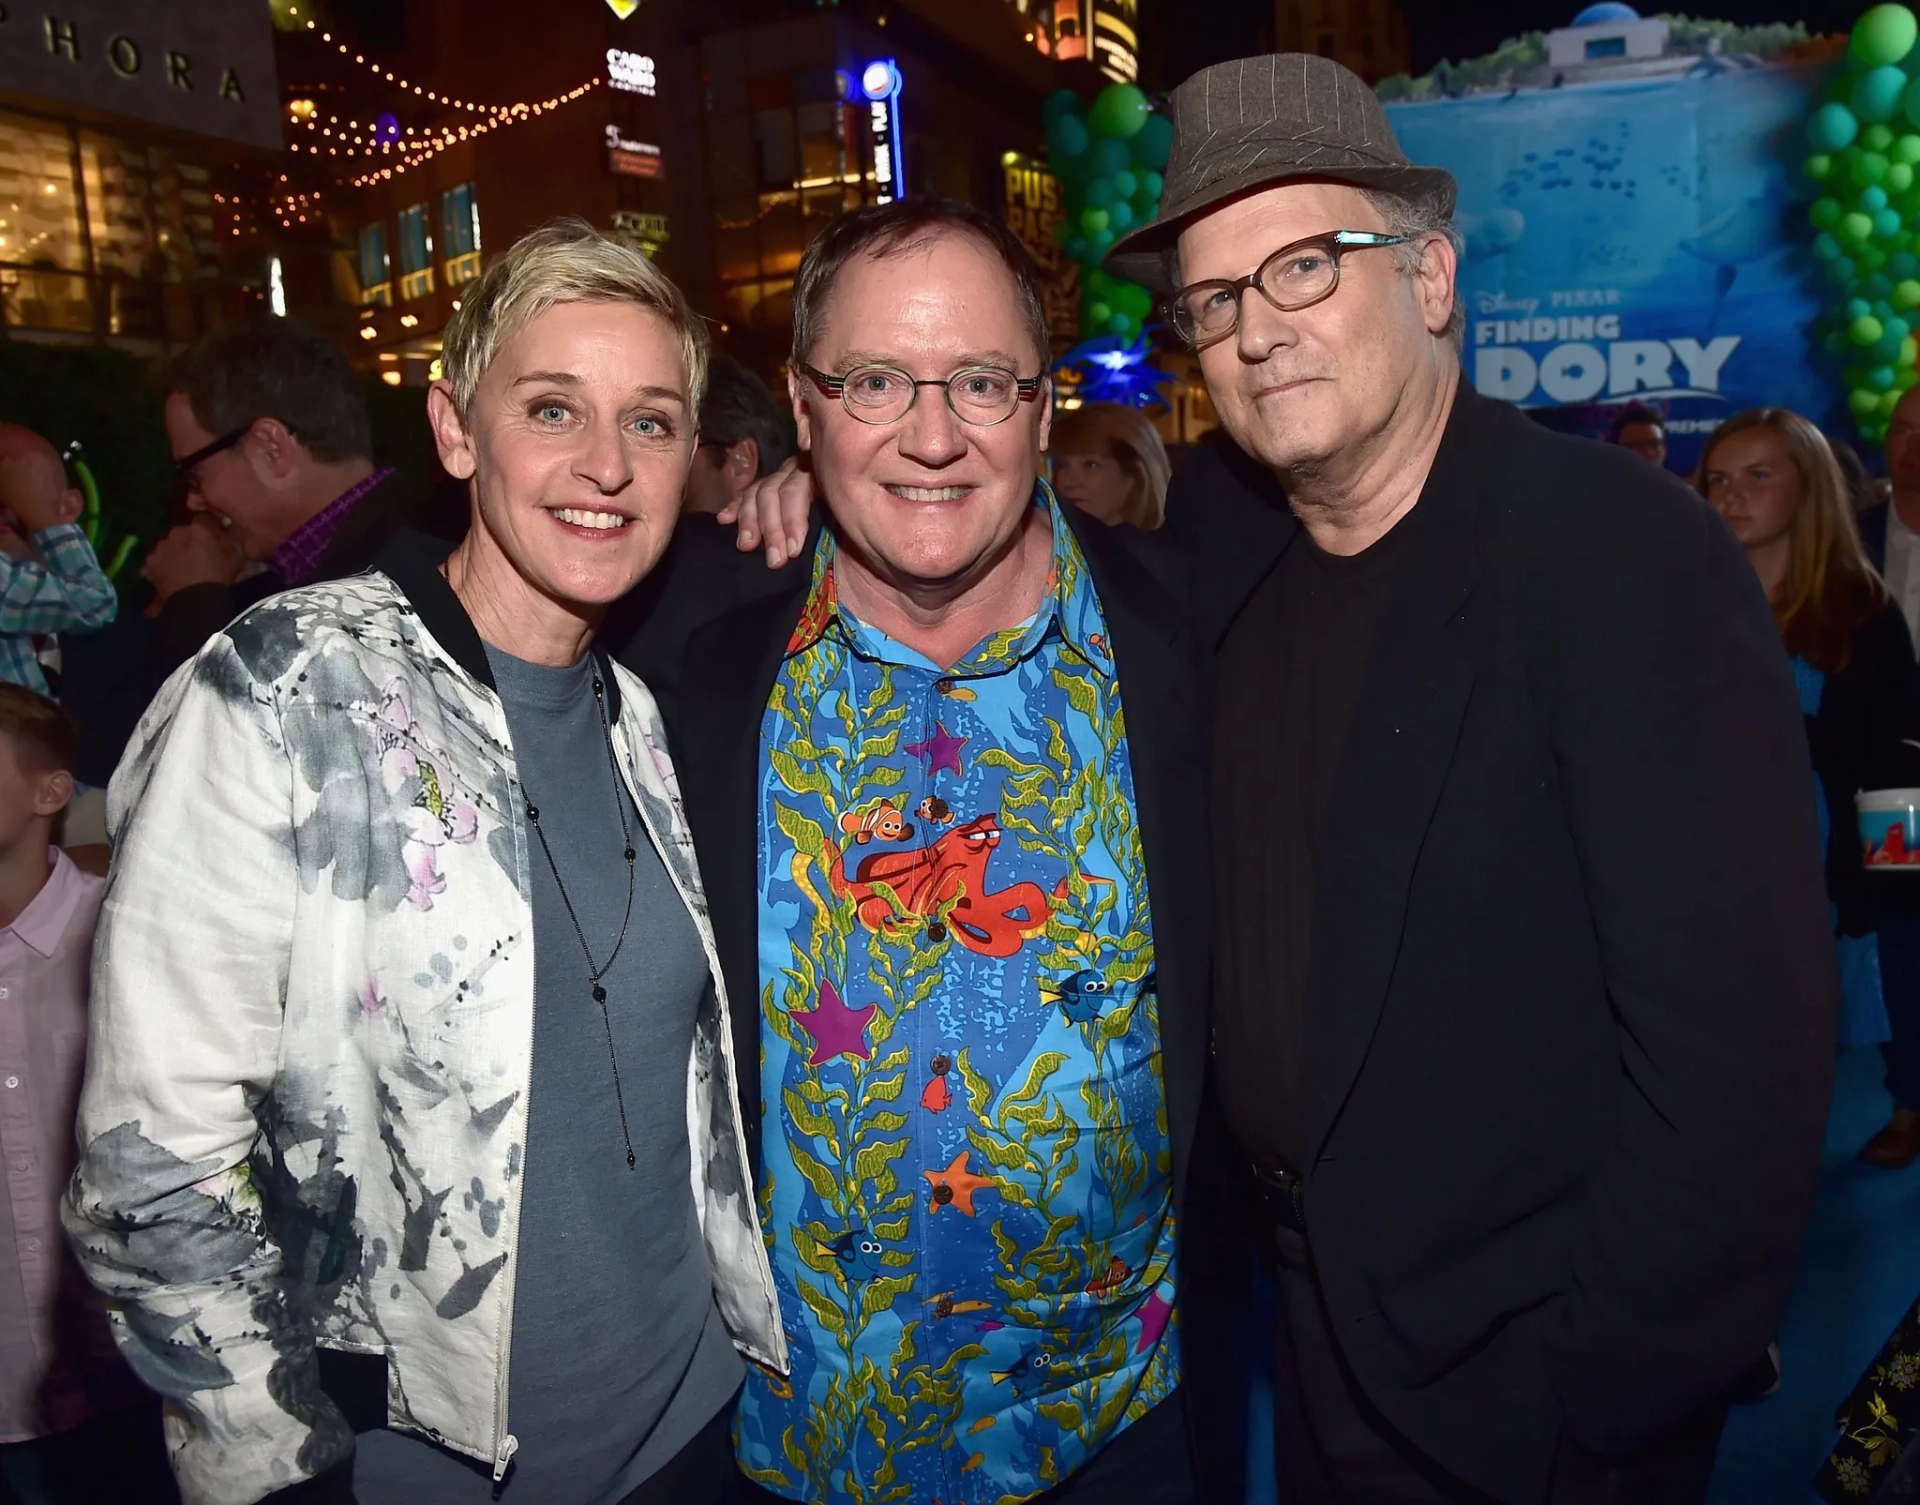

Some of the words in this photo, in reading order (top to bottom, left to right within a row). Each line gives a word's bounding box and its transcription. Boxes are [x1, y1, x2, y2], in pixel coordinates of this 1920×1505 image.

[0, 4, 245, 102] HORA
[1005, 167, 1057, 212] PUS
[1473, 289, 1540, 316] Disney
[1552, 289, 1621, 308] PIXAR
[1475, 314, 1621, 345] FINDING
[1475, 336, 1742, 402] DORY
